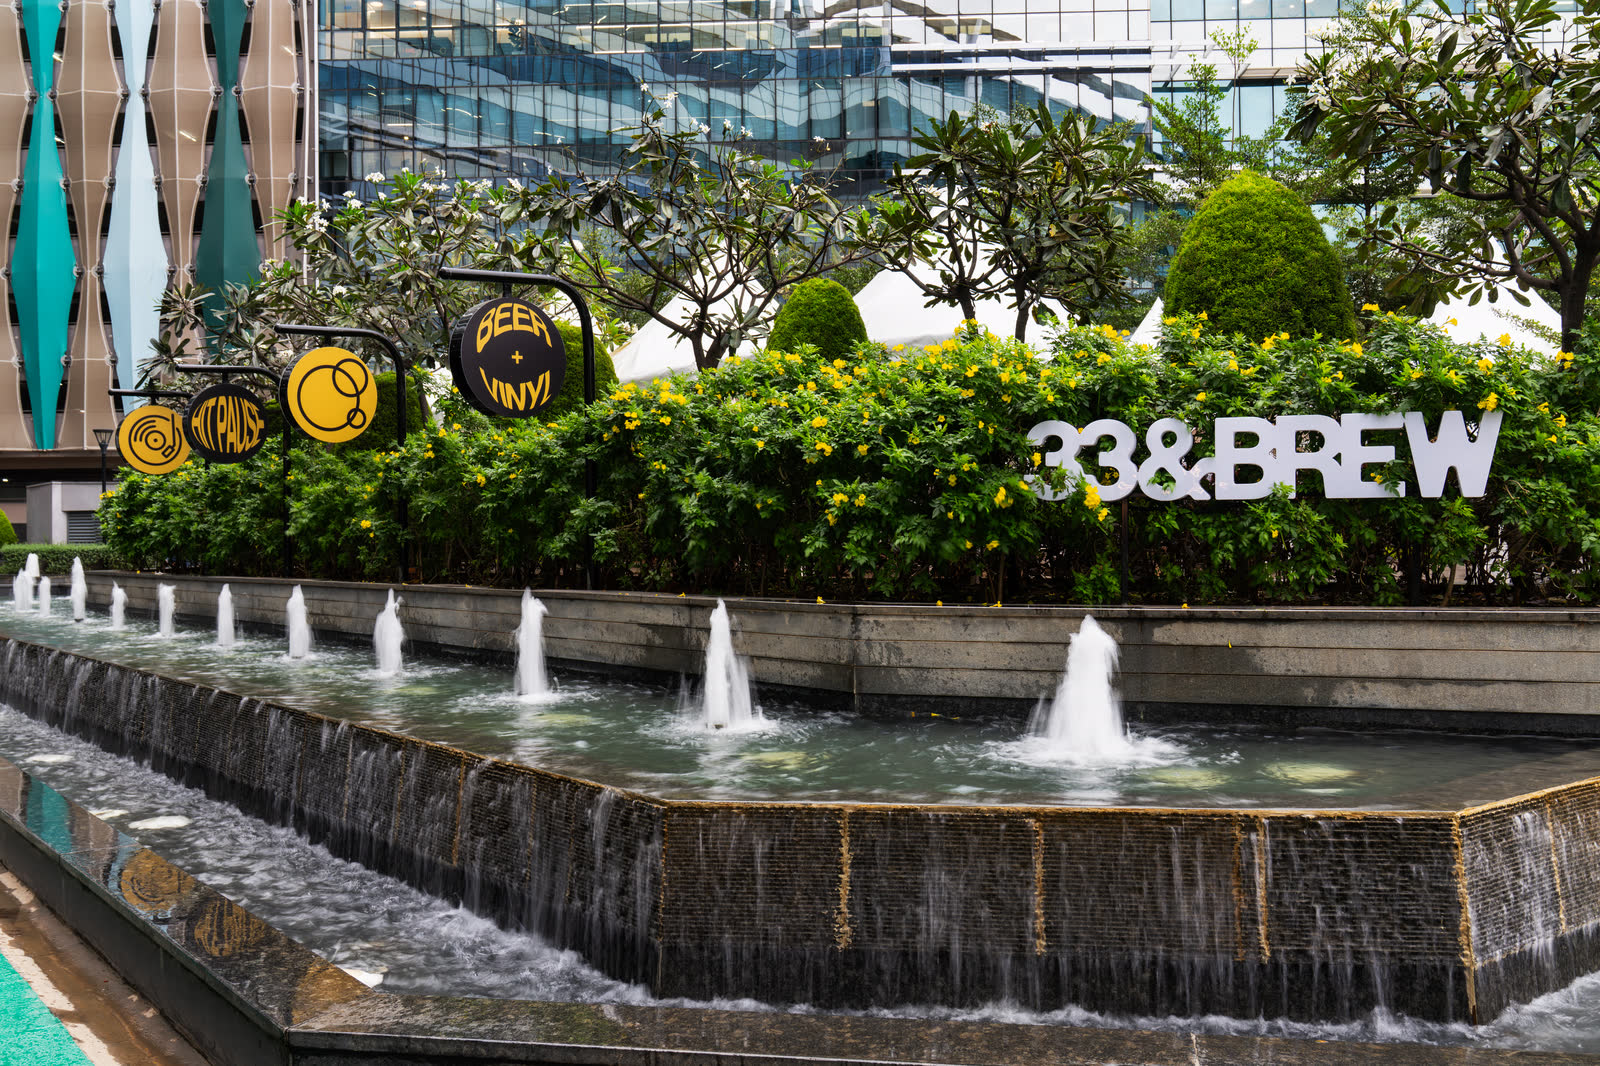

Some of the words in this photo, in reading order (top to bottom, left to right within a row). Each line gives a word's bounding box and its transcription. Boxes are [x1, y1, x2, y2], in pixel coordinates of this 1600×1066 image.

[476, 303, 553, 353] BEER
[511, 350, 523, 364] +
[479, 366, 552, 411] VINYL
[191, 397, 217, 451] HIT
[217, 395, 265, 454] PAUSE
